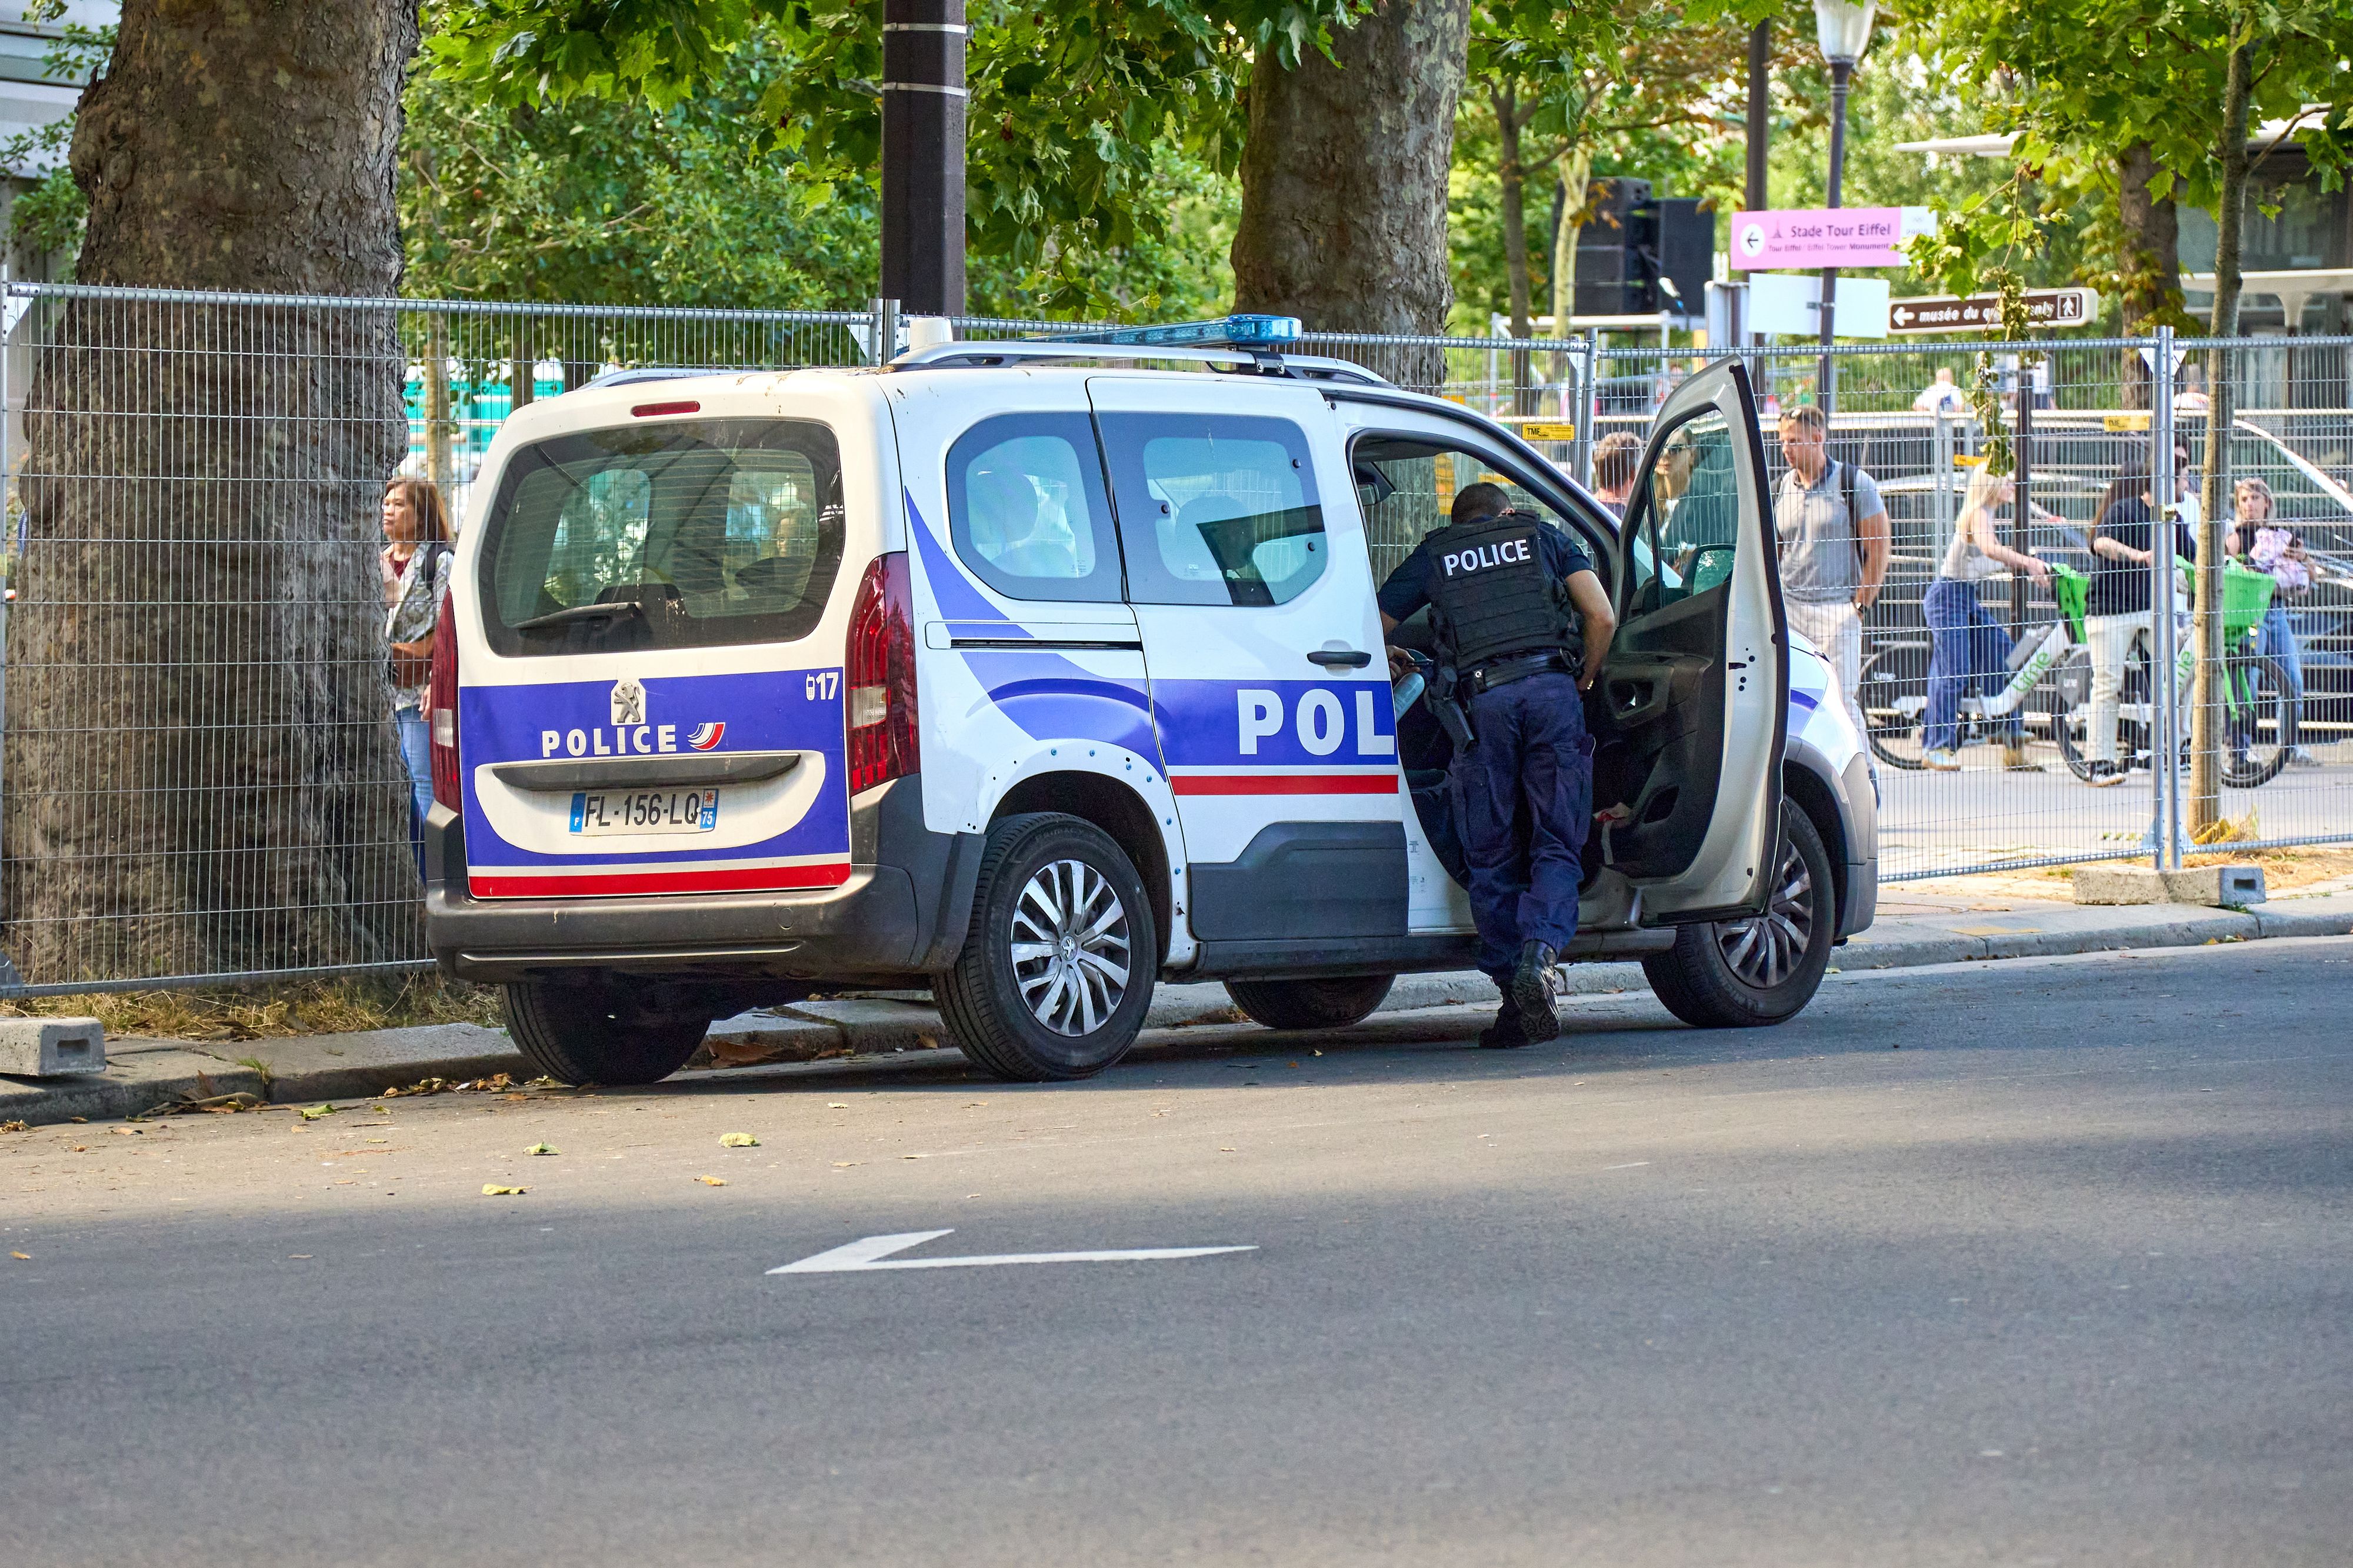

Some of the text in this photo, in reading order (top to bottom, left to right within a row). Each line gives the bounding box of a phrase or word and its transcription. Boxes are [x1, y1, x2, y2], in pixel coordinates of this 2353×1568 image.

[1791, 223, 1890, 237] Stade Tour Eiffel
[1919, 306, 1959, 322] musée
[1964, 305, 1979, 321] du
[1444, 539, 1531, 576] POLICE
[2012, 652, 2052, 691] Lime
[815, 672, 839, 700] 17
[1237, 689, 1394, 756] POL
[542, 725, 676, 758] POLICE
[574, 817, 579, 827] F
[702, 811, 713, 825] 75
